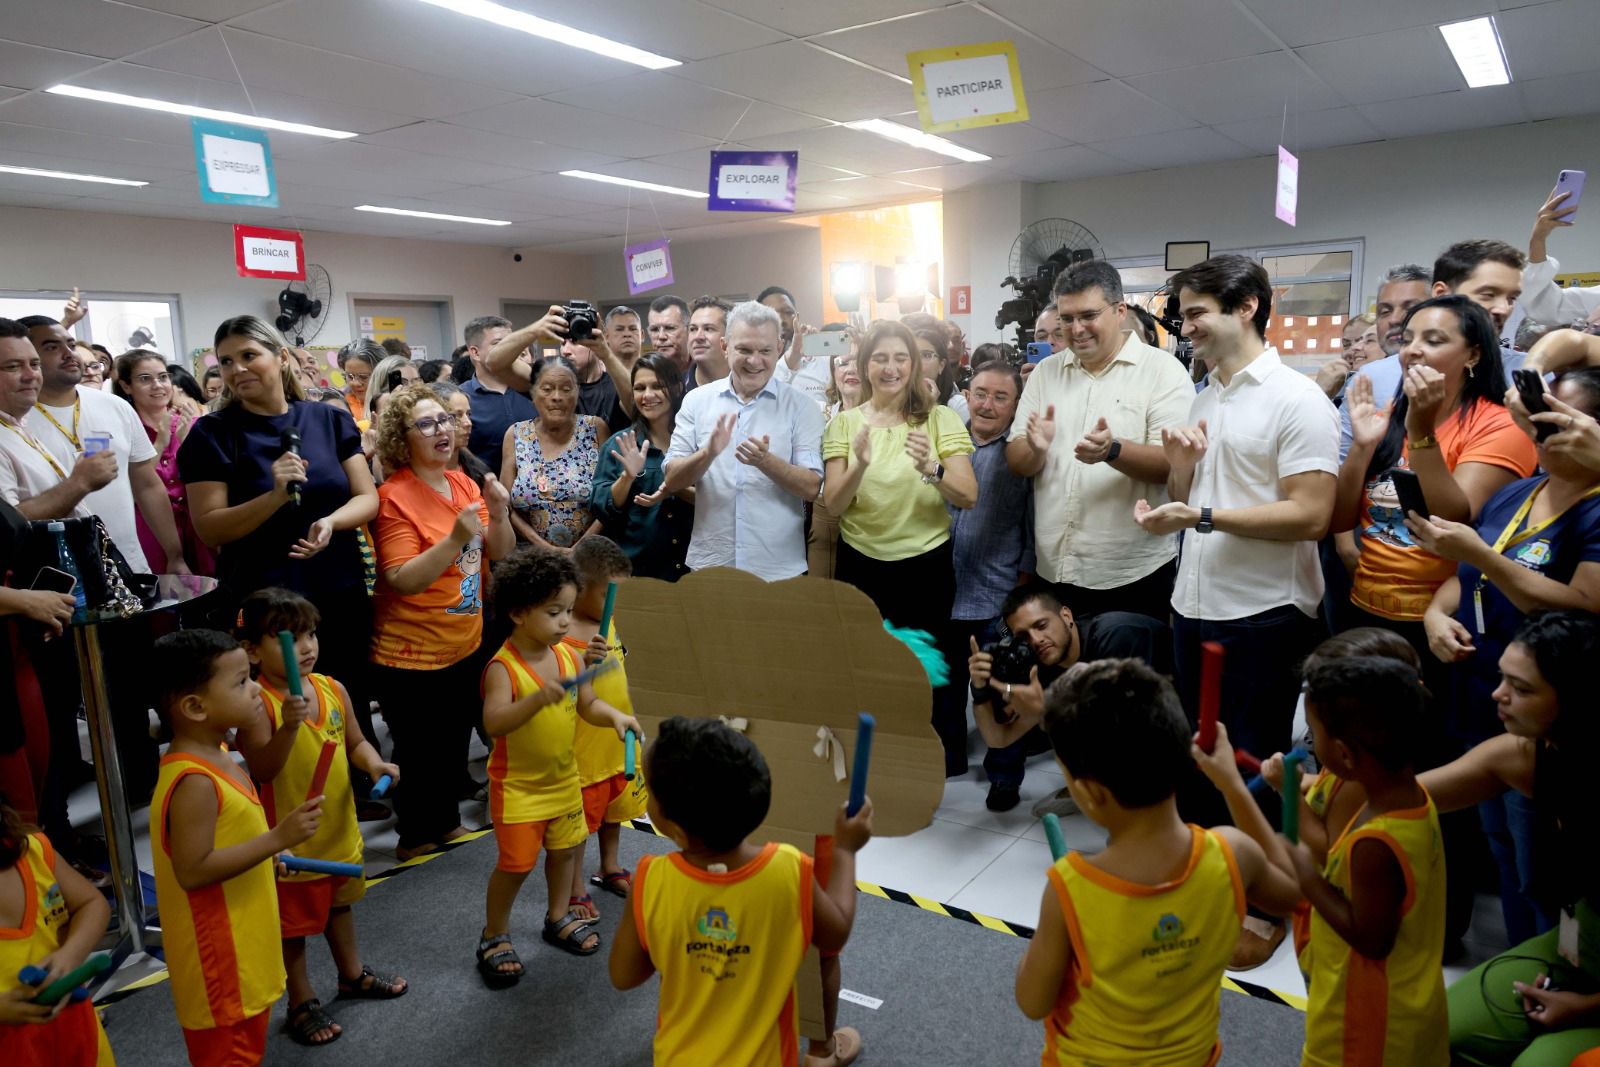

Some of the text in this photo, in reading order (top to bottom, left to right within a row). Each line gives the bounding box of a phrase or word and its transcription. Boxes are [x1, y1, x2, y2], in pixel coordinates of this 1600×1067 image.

[936, 78, 1004, 98] PARTICIPAR
[725, 174, 780, 184] EXPLORAR
[252, 247, 290, 258] BRINCAR
[635, 258, 664, 273] CONVIVER
